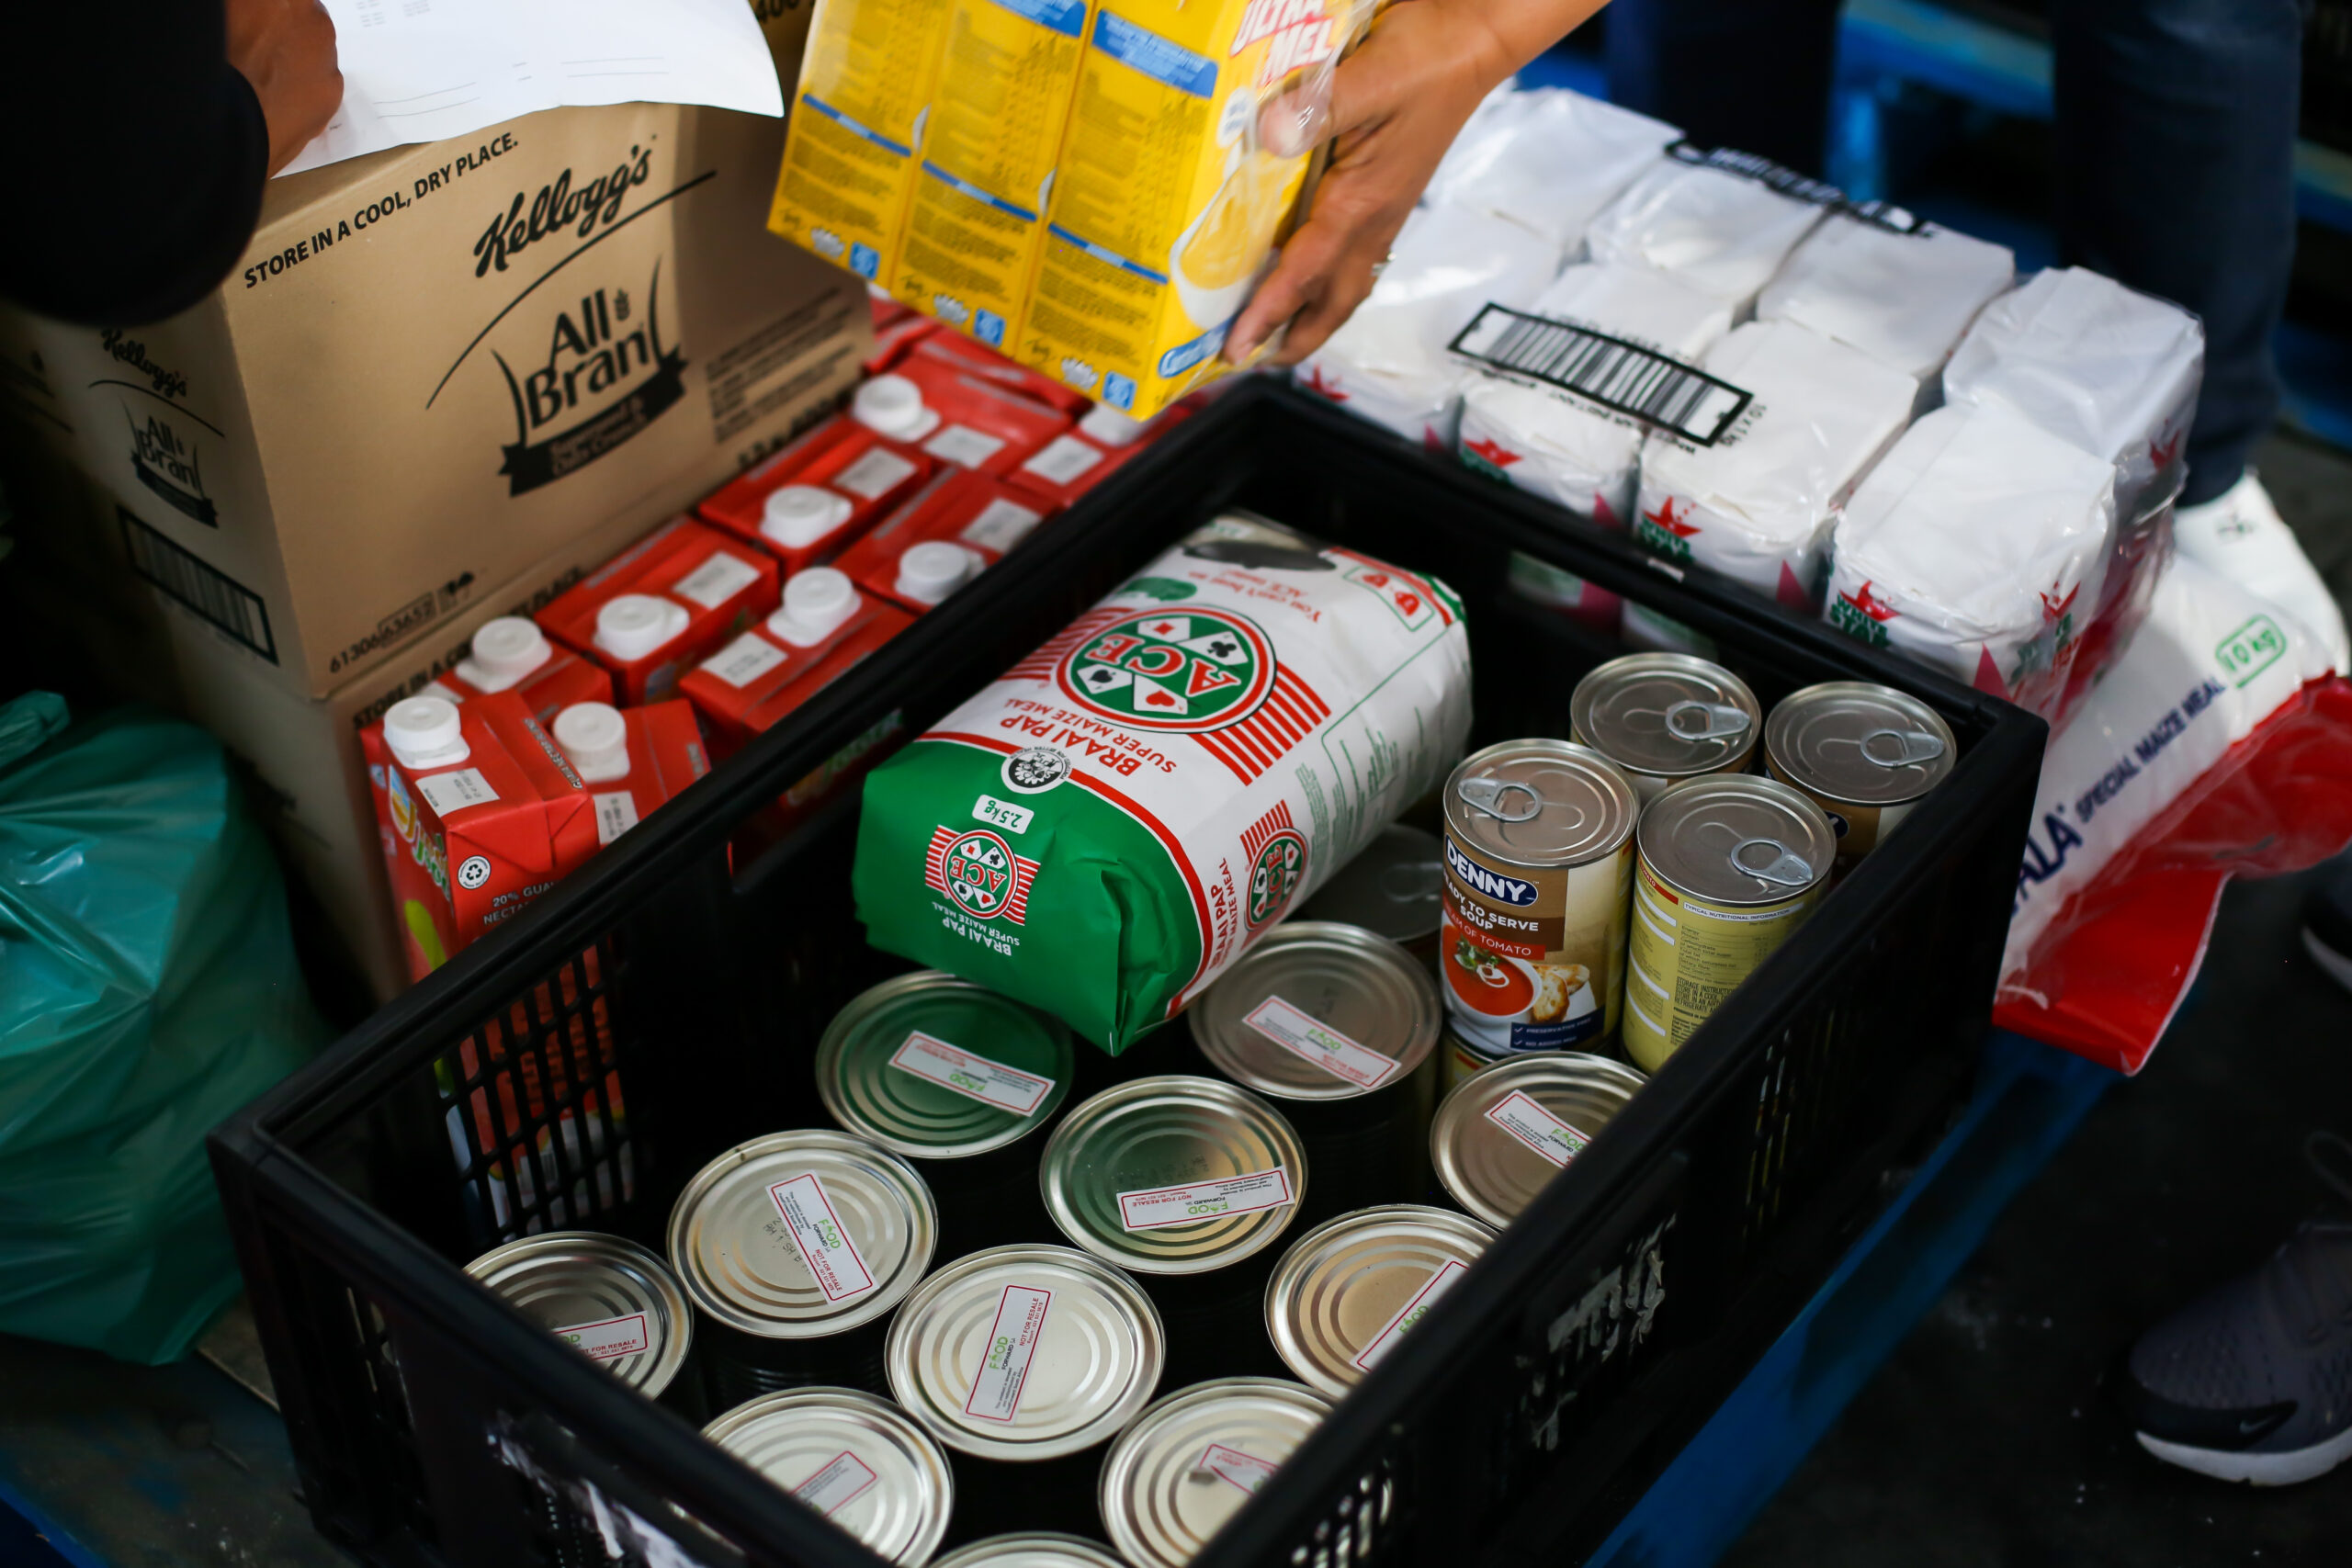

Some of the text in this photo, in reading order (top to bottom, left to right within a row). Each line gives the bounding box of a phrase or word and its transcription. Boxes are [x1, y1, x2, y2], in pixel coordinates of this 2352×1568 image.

[1261, 17, 1333, 86] MEL
[244, 132, 518, 288] STORE IN A COOL, DRY PLACE.
[473, 144, 652, 278] Kellogg's
[551, 288, 611, 360] All
[100, 328, 187, 398] Kellogg's
[525, 330, 650, 429] Bran
[146, 415, 175, 454] All
[137, 426, 197, 491] Bran
[1288, 601, 1321, 623] You
[1830, 604, 1891, 645] STAR
[1084, 633, 1242, 697] ACE
[1000, 714, 1142, 776] BRAAI PAP
[1003, 698, 1177, 773] SUPER MAIZE MEAL
[2012, 676, 2227, 917] ALA SPECIAL MAIZE MEAL
[950, 856, 1006, 892] ACE
[1218, 857, 1235, 891] MEAL
[1265, 845, 1284, 909] ACE
[1447, 839, 1527, 902] DENNY
[492, 881, 557, 908] 20% GUA
[1210, 884, 1228, 919] PAP
[1685, 904, 1791, 920] TYPICAL NUTRITIONAL INFORMATION
[483, 901, 530, 925] NECTA
[932, 901, 1020, 946] SUPER MAIZE MEAL
[1460, 905, 1494, 931] SOUP
[1468, 901, 1486, 916] TO
[1488, 913, 1539, 931] SERVE
[943, 918, 1012, 956] BRAAI PAP
[1464, 925, 1532, 956] OF TOMATO
[1676, 983, 1690, 993] STORE
[1677, 976, 1700, 988] STORAGE
[1674, 997, 1708, 1011] REFRIGERATE
[1548, 1134, 1573, 1151] FORWARD
[1193, 1196, 1225, 1204] FORWARD
[812, 1224, 827, 1247] FORWARD
[815, 1248, 842, 1291] NOT FOR RESALE
[1026, 1297, 1038, 1320] RESALE
[607, 1338, 637, 1348] RESALE
[1023, 1321, 1031, 1333] FOR
[1001, 1344, 1013, 1370] FORWARD
